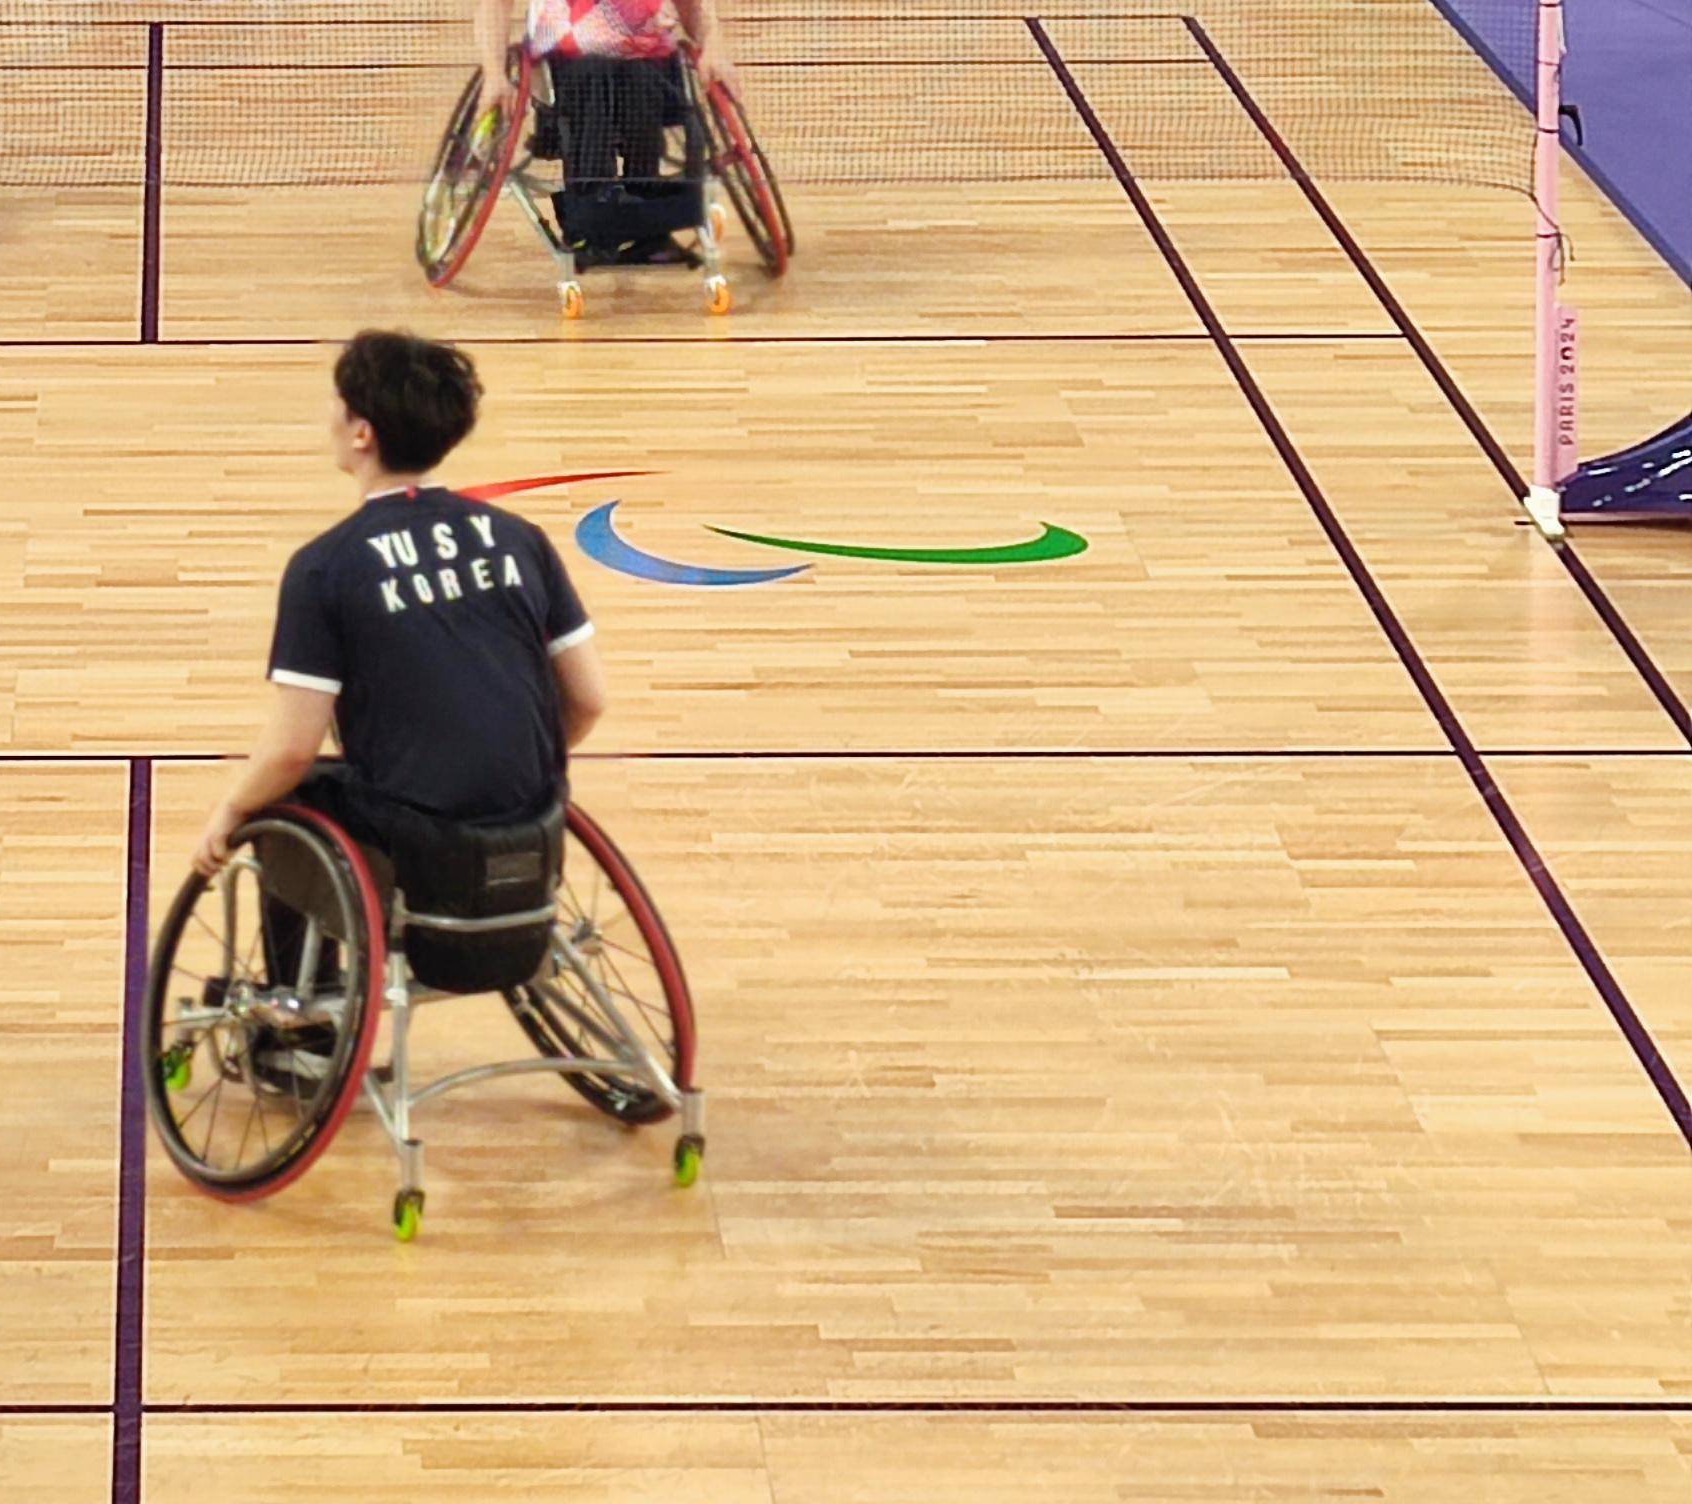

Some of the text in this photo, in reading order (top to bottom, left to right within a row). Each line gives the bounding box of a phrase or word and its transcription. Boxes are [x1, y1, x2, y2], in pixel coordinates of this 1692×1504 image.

[1558, 317, 1576, 446] PARIS 2024
[367, 530, 419, 569] YU
[379, 553, 523, 614] KOREA
